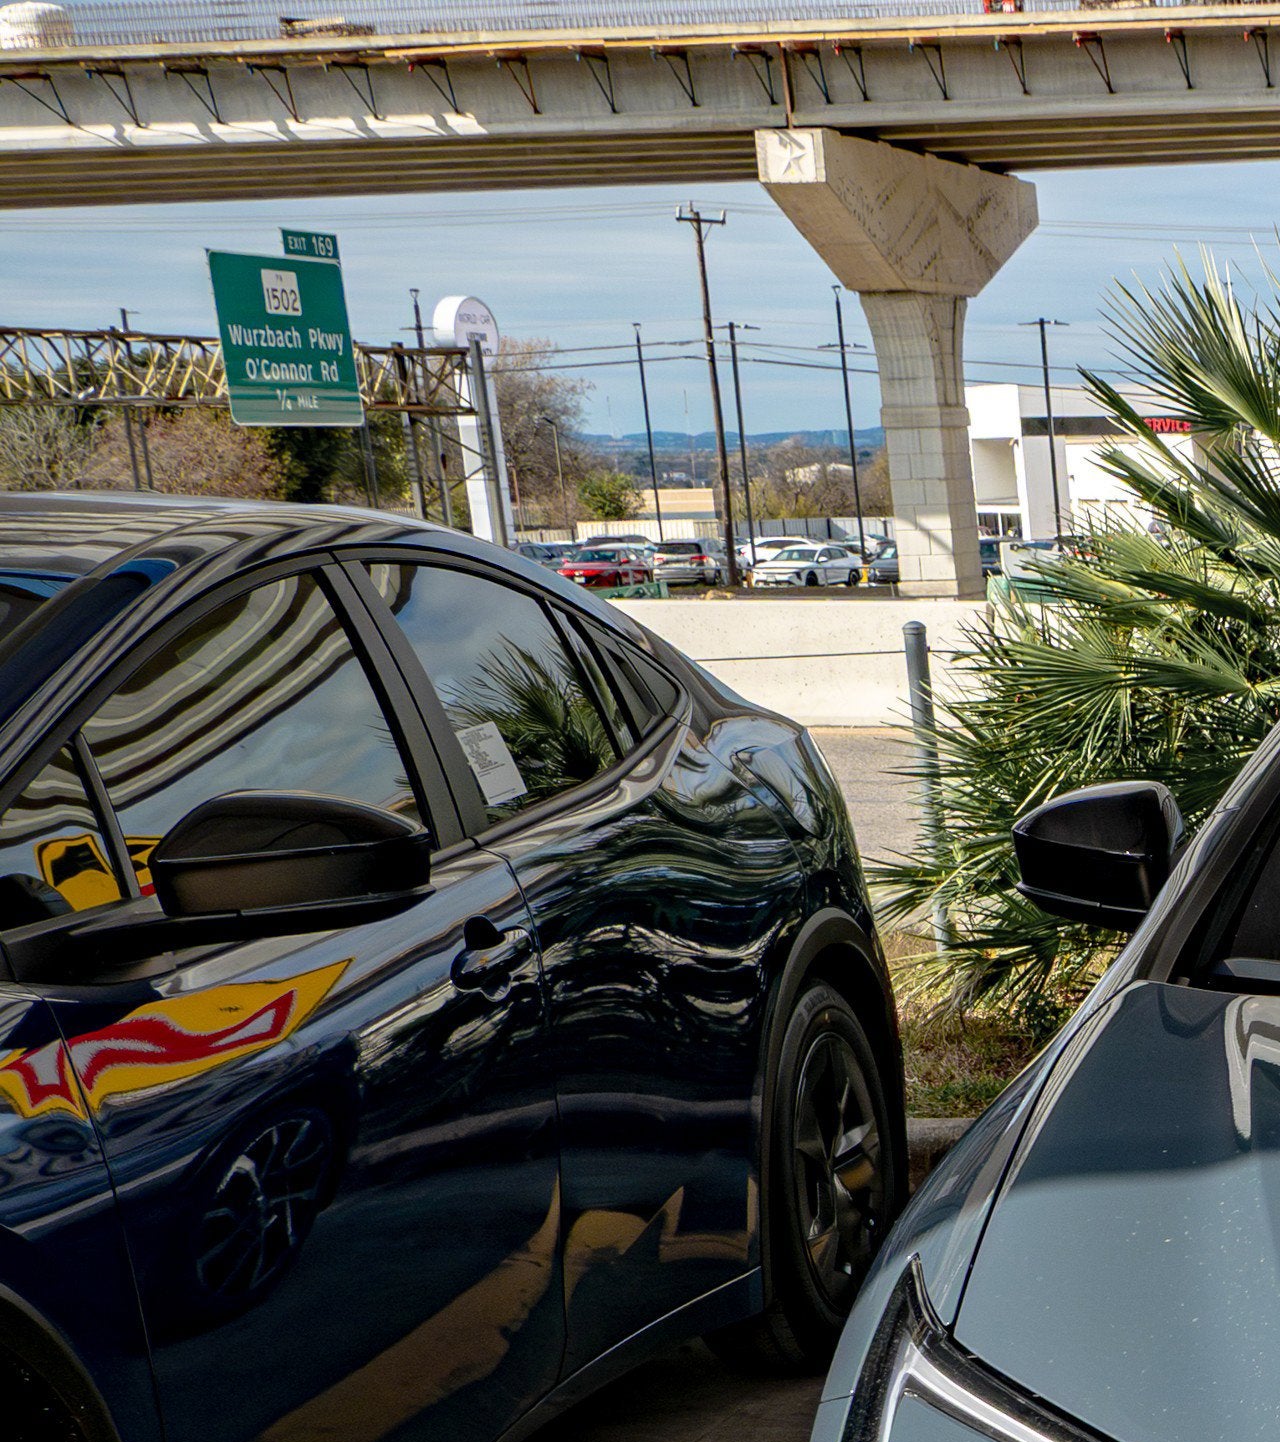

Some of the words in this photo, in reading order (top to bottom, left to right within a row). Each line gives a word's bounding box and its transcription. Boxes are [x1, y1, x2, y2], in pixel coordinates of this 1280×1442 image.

[287, 235, 307, 251] EXIT
[312, 235, 333, 257] 169
[266, 287, 300, 312] 1502
[227, 323, 303, 349] Wurzbach
[308, 327, 344, 357] Pkwy
[245, 357, 314, 382] O'Connor
[320, 360, 340, 383] Rd
[296, 394, 319, 409] MILE
